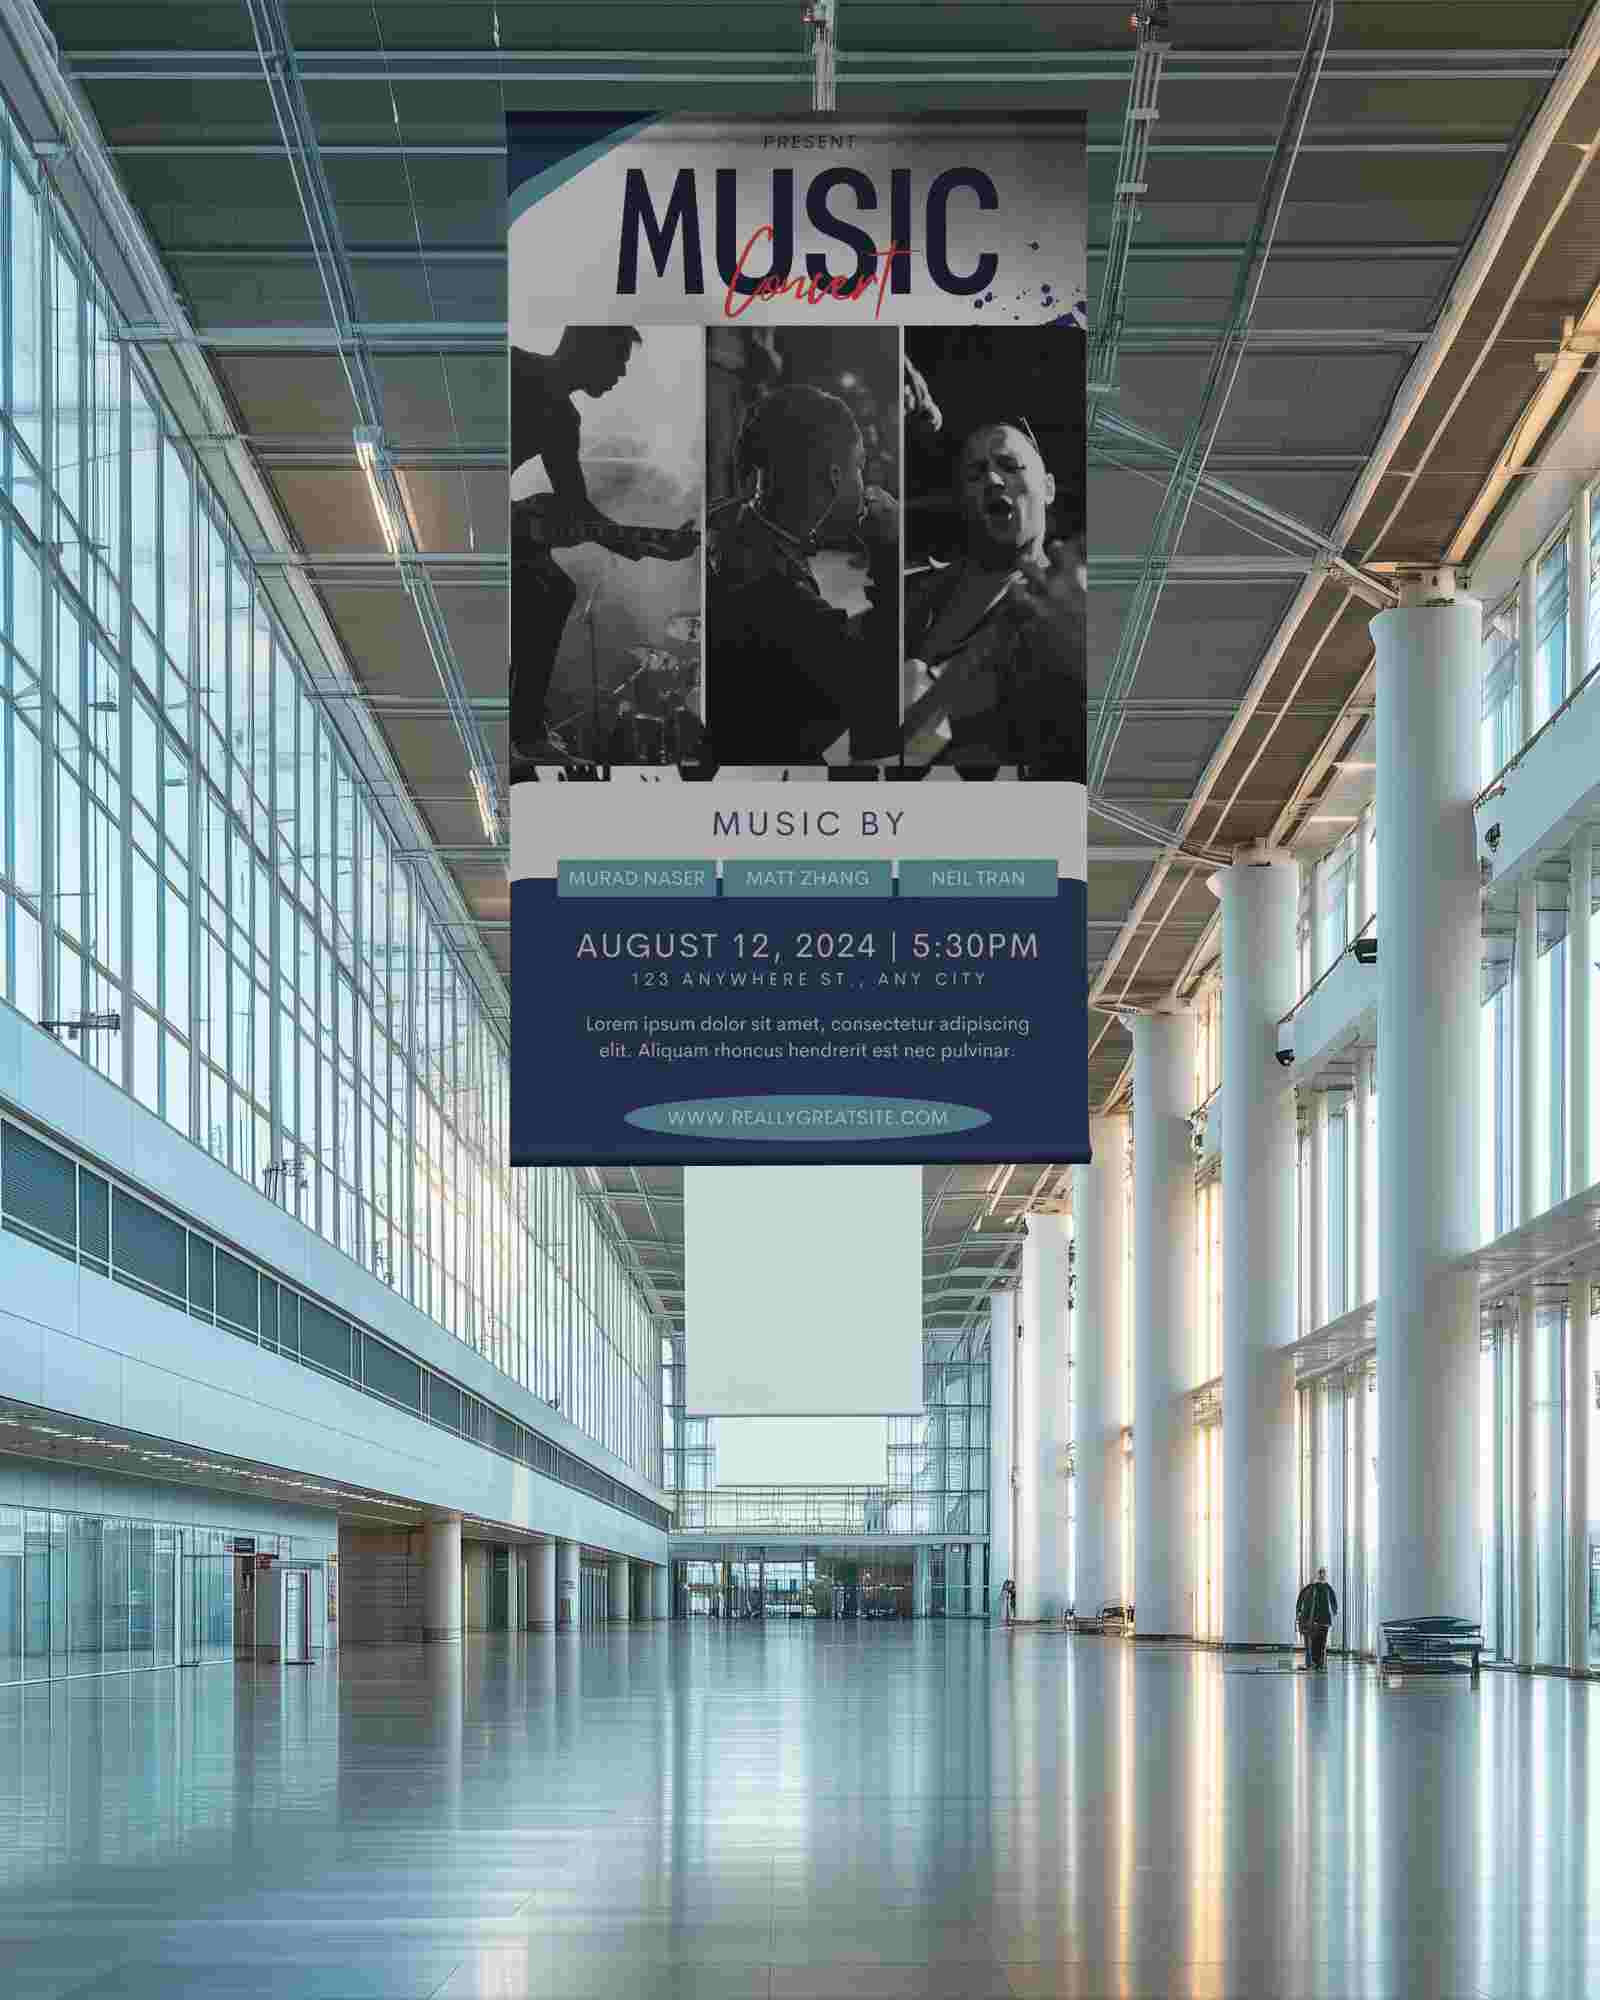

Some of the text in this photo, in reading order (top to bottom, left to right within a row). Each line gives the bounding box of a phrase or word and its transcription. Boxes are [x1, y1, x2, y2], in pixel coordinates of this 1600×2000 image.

[763, 134, 857, 149] PRESENT
[616, 167, 999, 295] MUSIC
[724, 224, 920, 320] Concert
[712, 811, 905, 836] MUSIC BY
[568, 871, 705, 887] MURAD NASER
[746, 871, 870, 887] MATT ZHANG
[931, 871, 1025, 887] NEIL TRAN
[576, 933, 718, 958] AUGUST
[733, 933, 780, 964] 12,
[796, 933, 876, 958] 2024
[912, 933, 1039, 958] 5:30PM
[631, 972, 669, 986] 123
[681, 972, 809, 986] ANYWHERE
[877, 972, 921, 986] ANY
[935, 972, 986, 986] CITY
[585, 1016, 1030, 1037] Lorem ipsum dolor sit amet, consectetur adipiscing
[599, 1042, 633, 1057] elit.
[638, 1042, 708, 1062] Aliquam
[714, 1042, 783, 1058] rhoncus
[788, 1042, 867, 1058] hendrerit
[872, 1043, 899, 1058] est
[904, 1046, 936, 1058] nec
[667, 1110, 948, 1126] WWW.REALLYGREATSITE.COM
